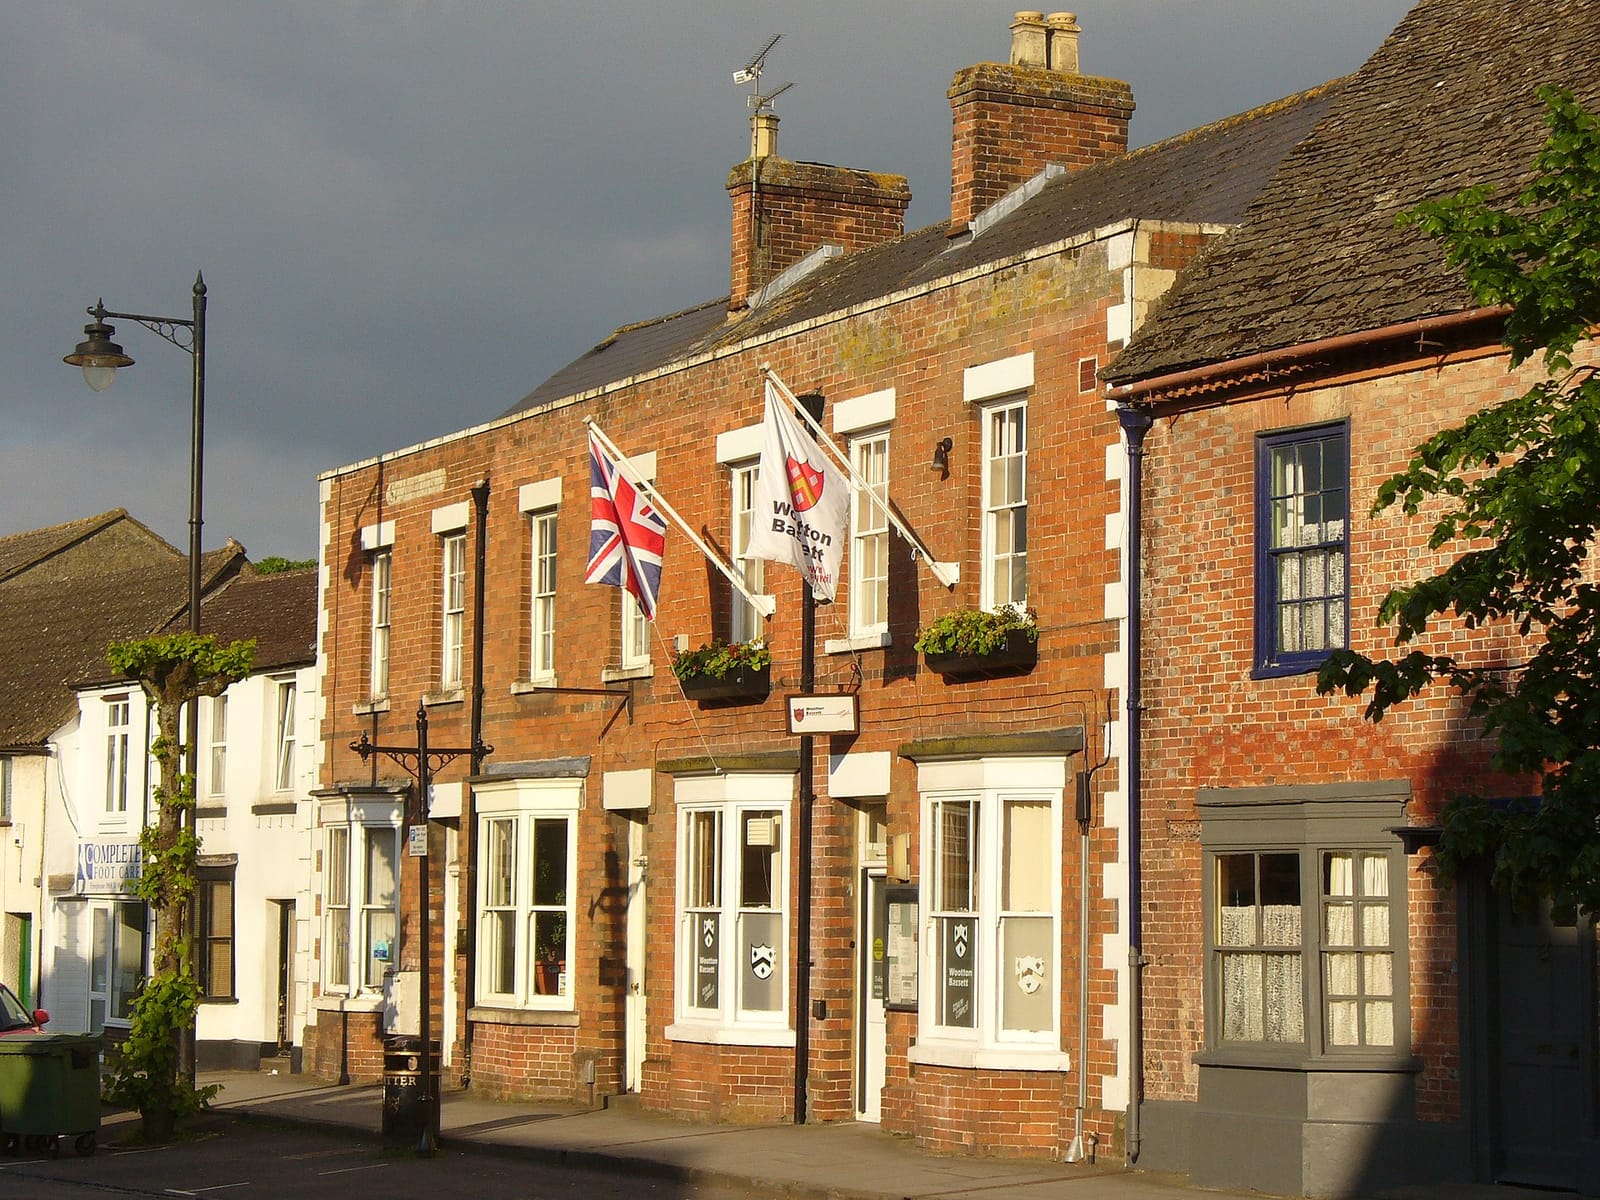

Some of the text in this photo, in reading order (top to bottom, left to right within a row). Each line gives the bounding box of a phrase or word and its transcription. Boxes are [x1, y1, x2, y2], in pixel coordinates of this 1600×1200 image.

[87, 844, 140, 864] COMPLETE
[94, 866, 140, 879] FOOT CARE
[949, 967, 972, 976] Wootton
[949, 978, 968, 987] Bassett
